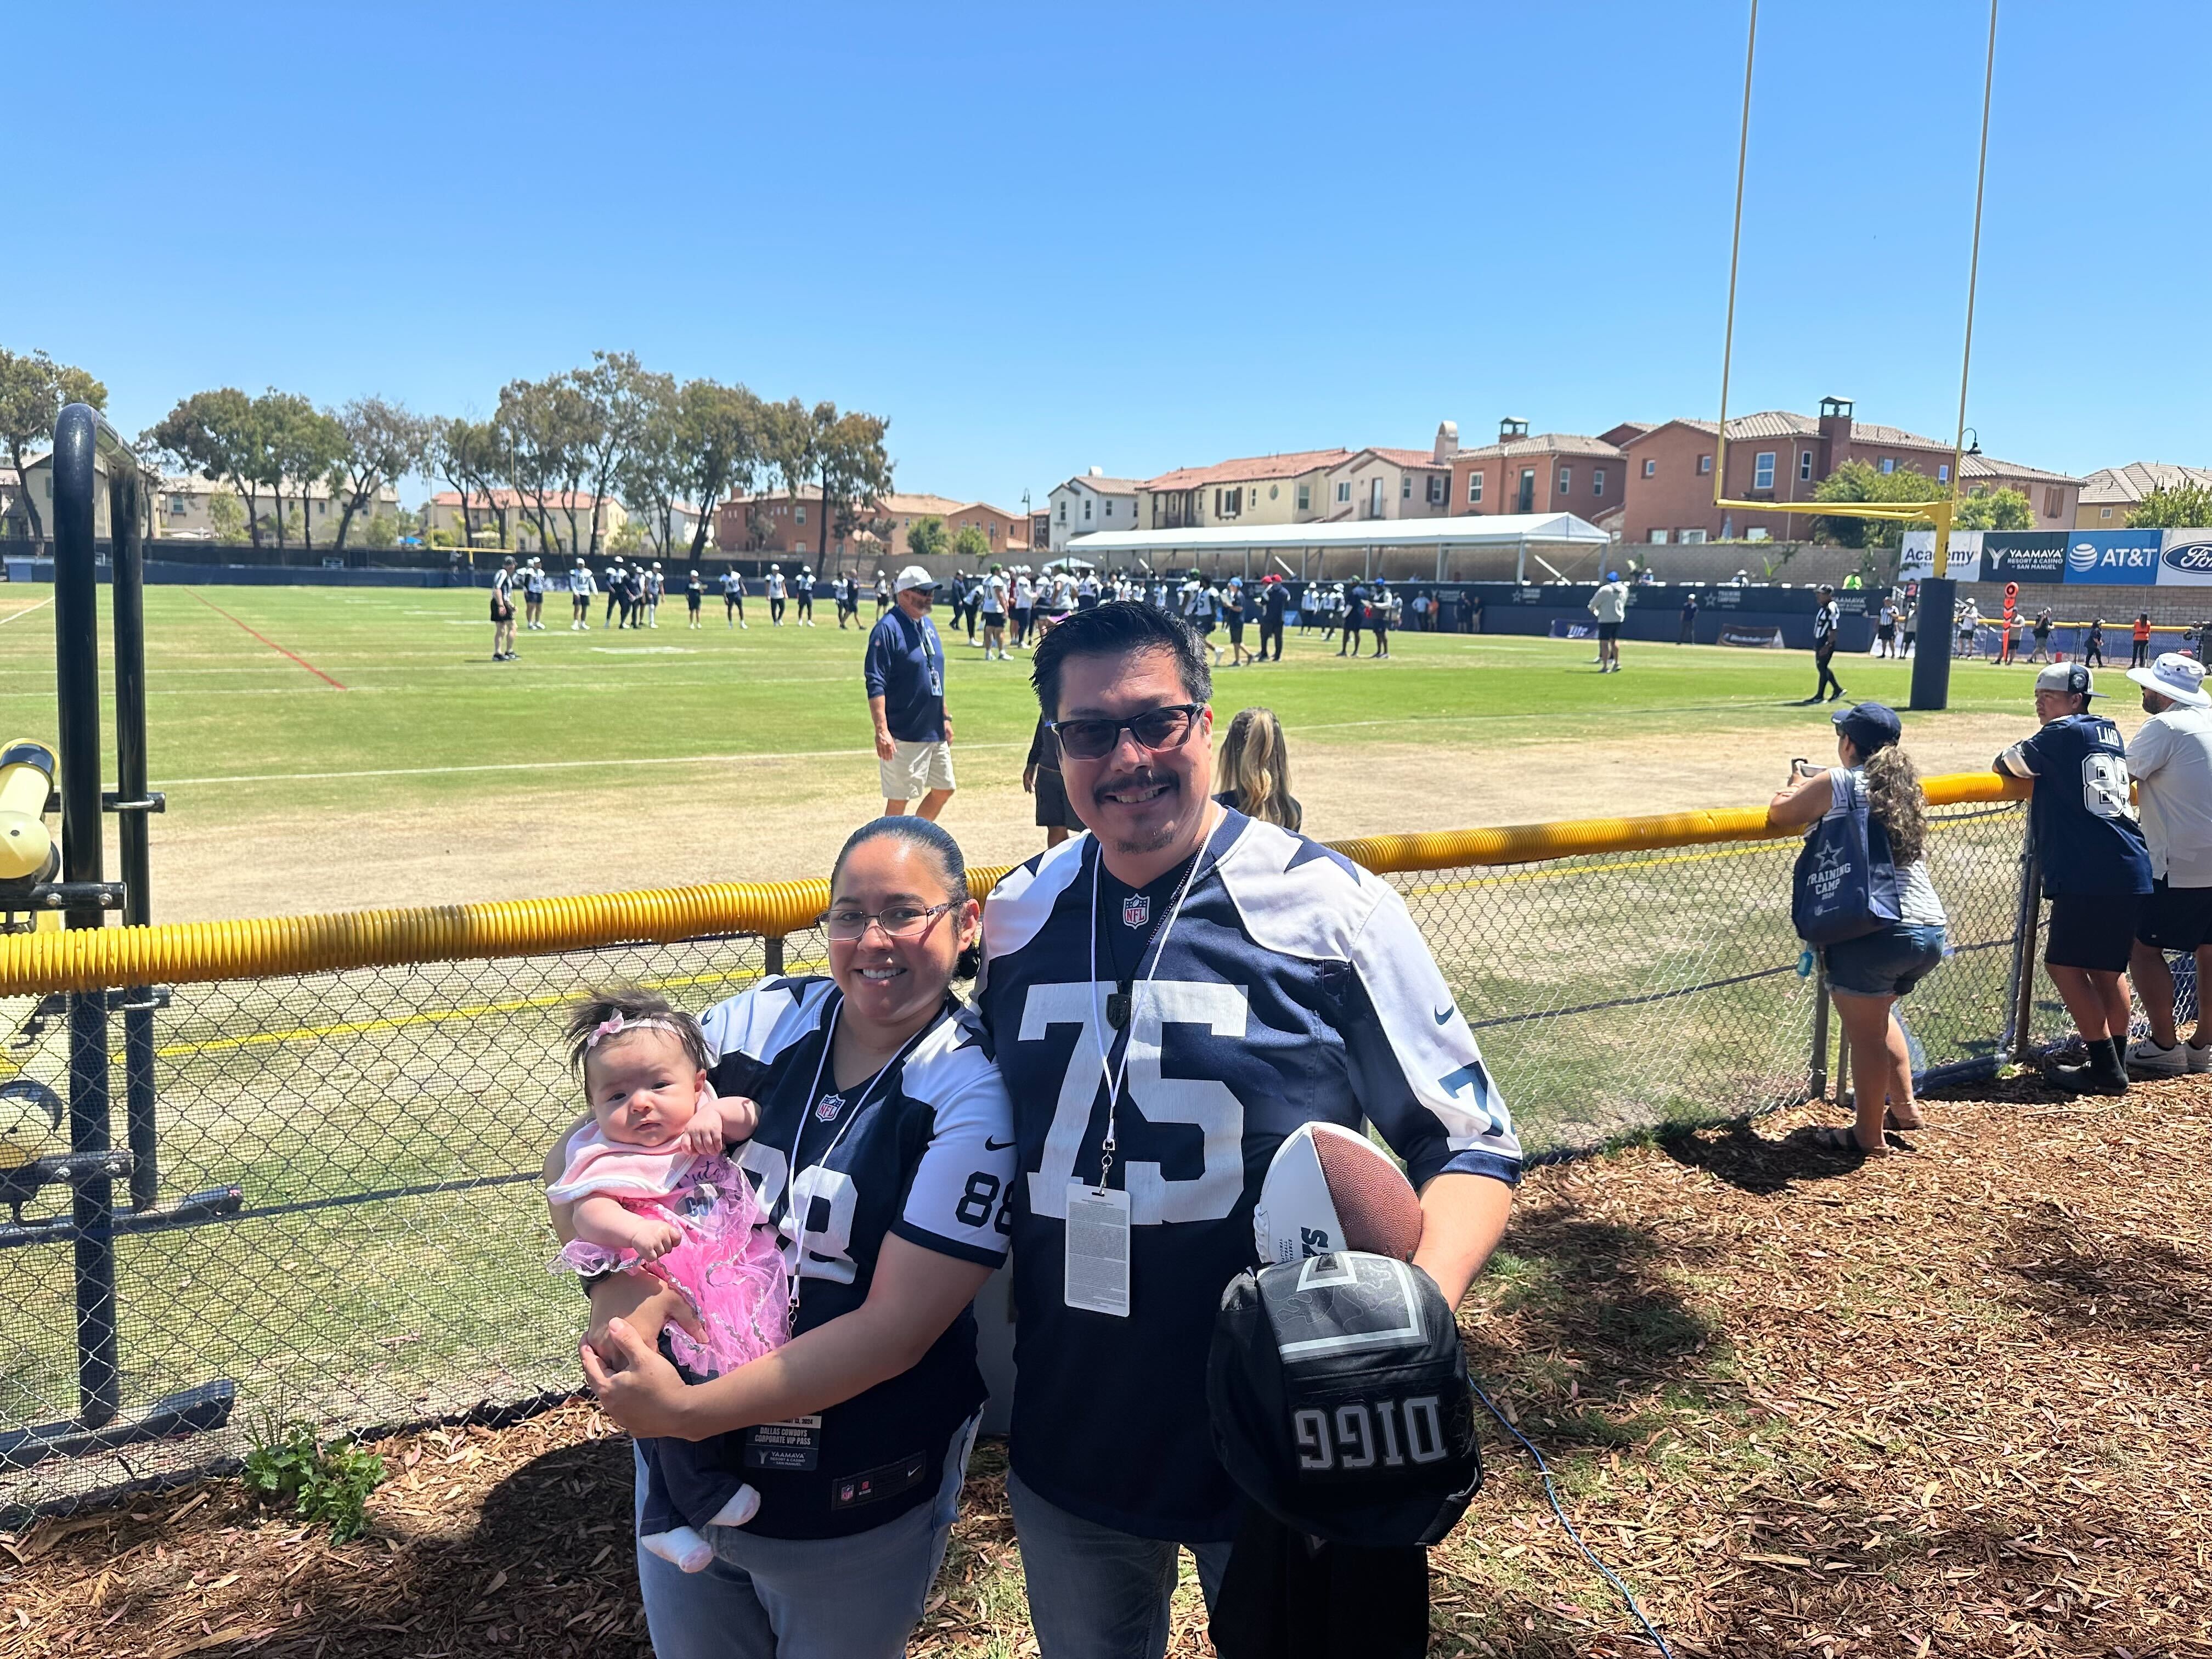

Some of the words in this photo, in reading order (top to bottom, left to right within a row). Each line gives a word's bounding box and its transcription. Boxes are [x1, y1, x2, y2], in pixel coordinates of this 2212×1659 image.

[1905, 548, 1974, 565] Acamy
[2100, 548, 2158, 567] AT&T
[2096, 726, 2119, 747] LAMB
[2081, 752, 2134, 819] 88
[1807, 862, 1851, 886] TRAINING
[1815, 878, 1840, 895] CAMP
[1126, 908, 1145, 923] NFL
[1018, 980, 1249, 1225] 75
[1437, 1060, 1516, 1137] 7
[819, 1104, 834, 1117] NFL
[755, 1435, 786, 1443] CORPORATE
[787, 1436, 795, 1444] VIP
[796, 1437, 811, 1446] PASS
[760, 1427, 780, 1435] DALLAS
[781, 1428, 808, 1437] COWBOYS
[1294, 1395, 1448, 1470] DIGG
